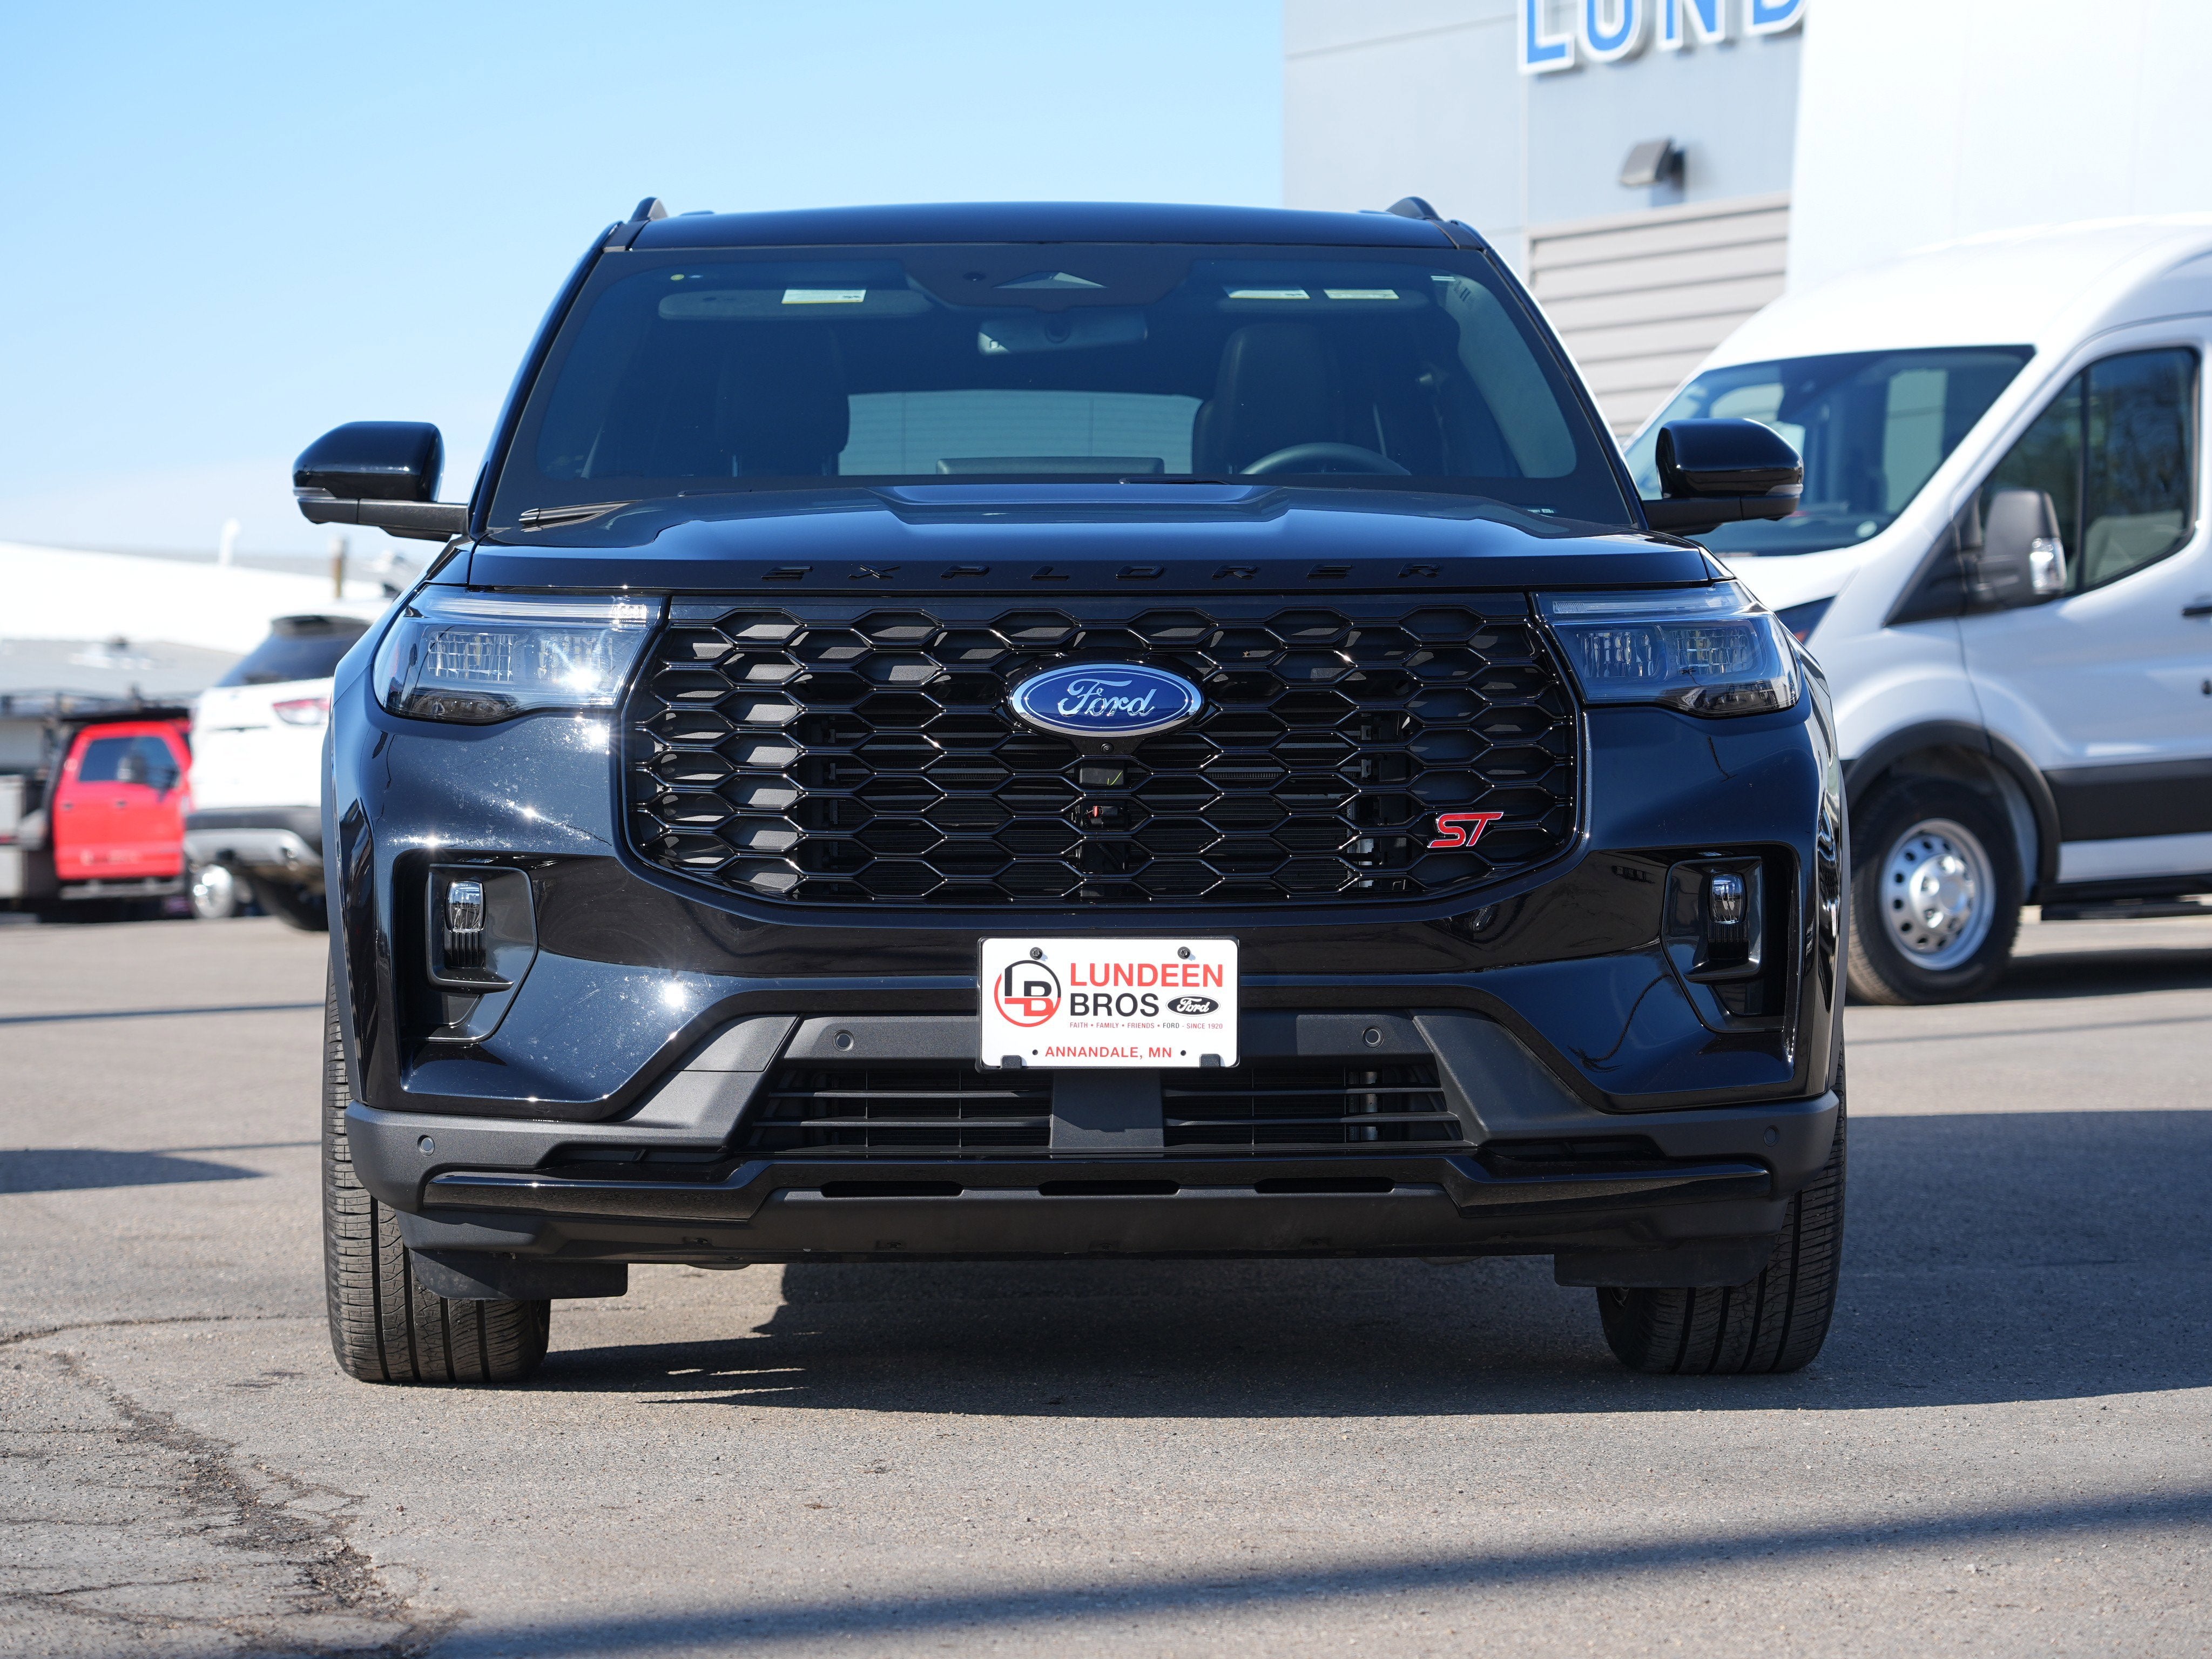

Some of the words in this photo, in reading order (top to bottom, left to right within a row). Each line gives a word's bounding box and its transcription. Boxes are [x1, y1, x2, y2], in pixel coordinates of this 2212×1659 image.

[761, 563, 1442, 582] EXPLORER
[1057, 678, 1157, 717] Ford
[1427, 812, 1504, 848] ST
[1070, 962, 1223, 987] LUNDEEN
[1070, 993, 1159, 1017] BROS
[1176, 997, 1211, 1013] Ford
[1045, 1046, 1143, 1060] ANNANDALE,
[1149, 1047, 1171, 1058] MN
